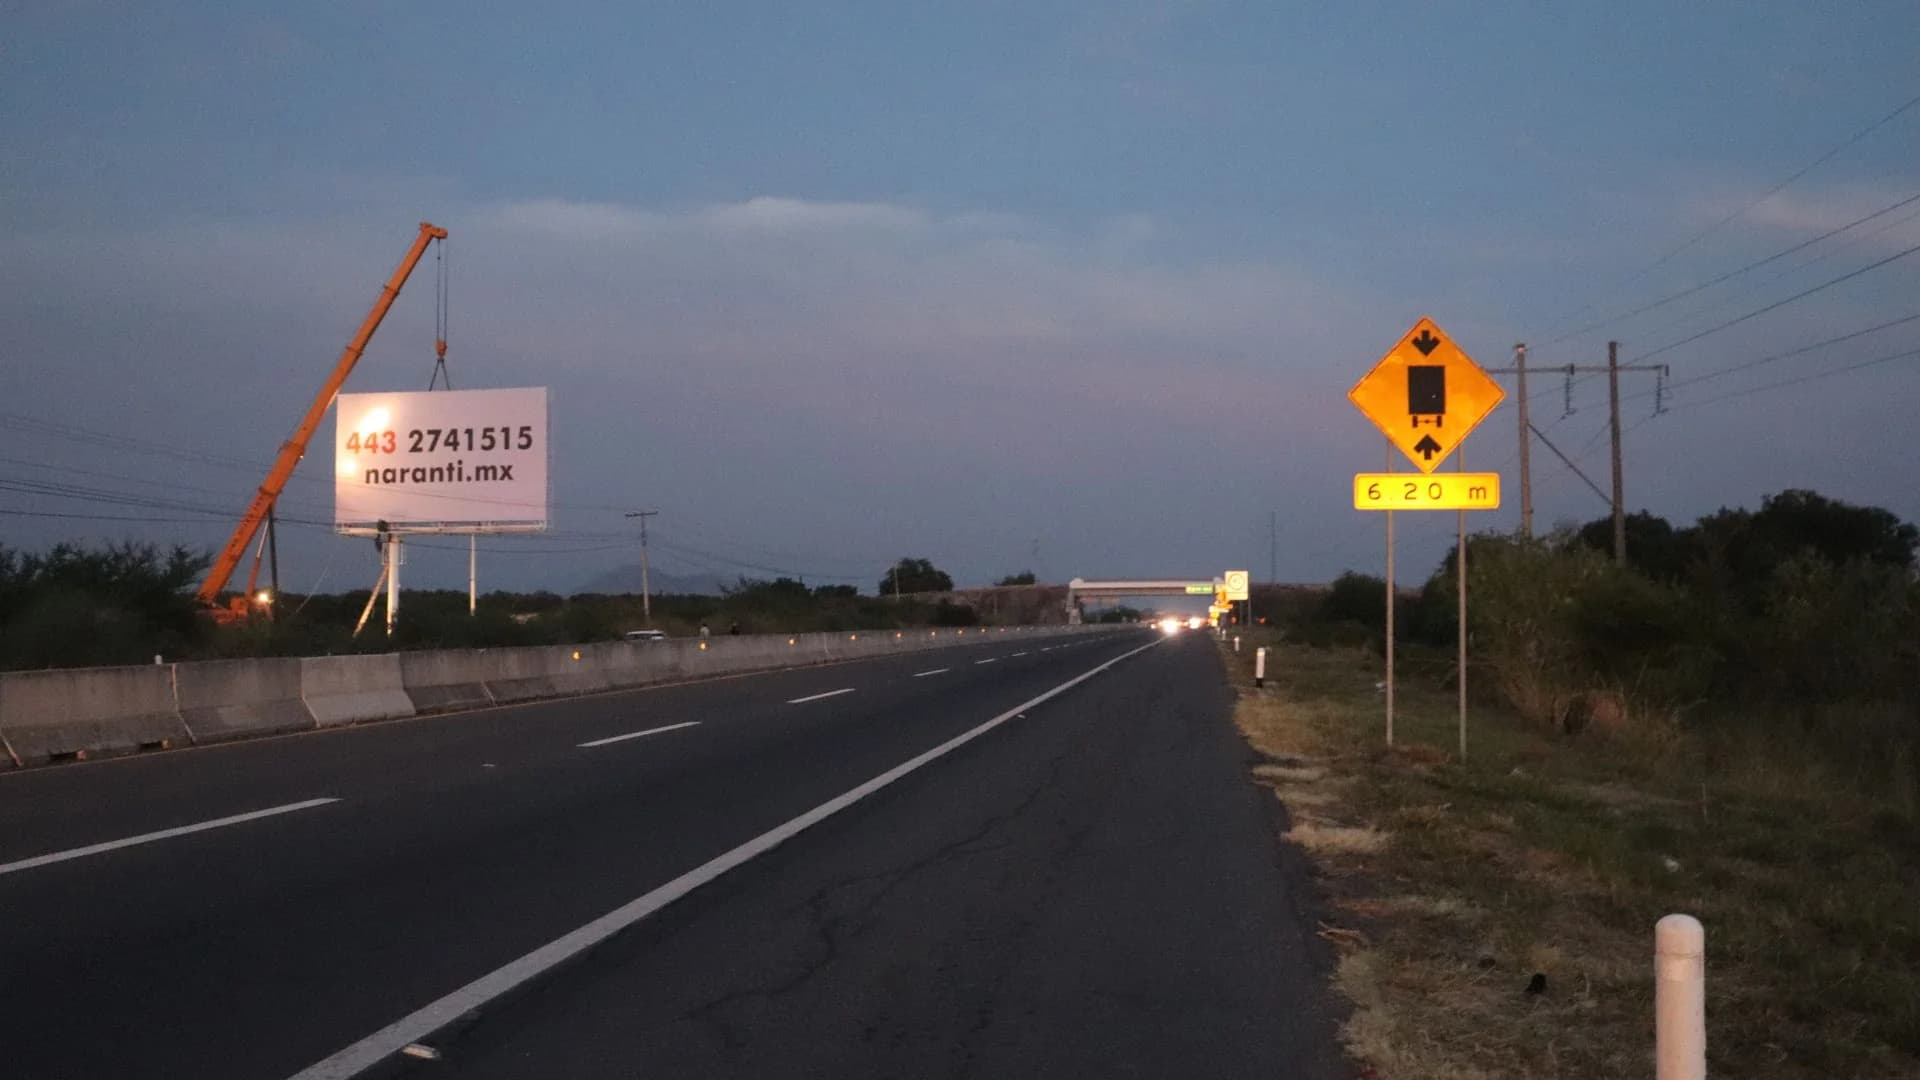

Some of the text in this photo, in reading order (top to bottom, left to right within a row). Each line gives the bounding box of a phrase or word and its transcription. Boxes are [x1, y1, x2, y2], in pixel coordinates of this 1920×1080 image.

[346, 426, 533, 454] 443 2741515
[365, 460, 514, 484] naranti.mx
[1470, 486, 1487, 500] m
